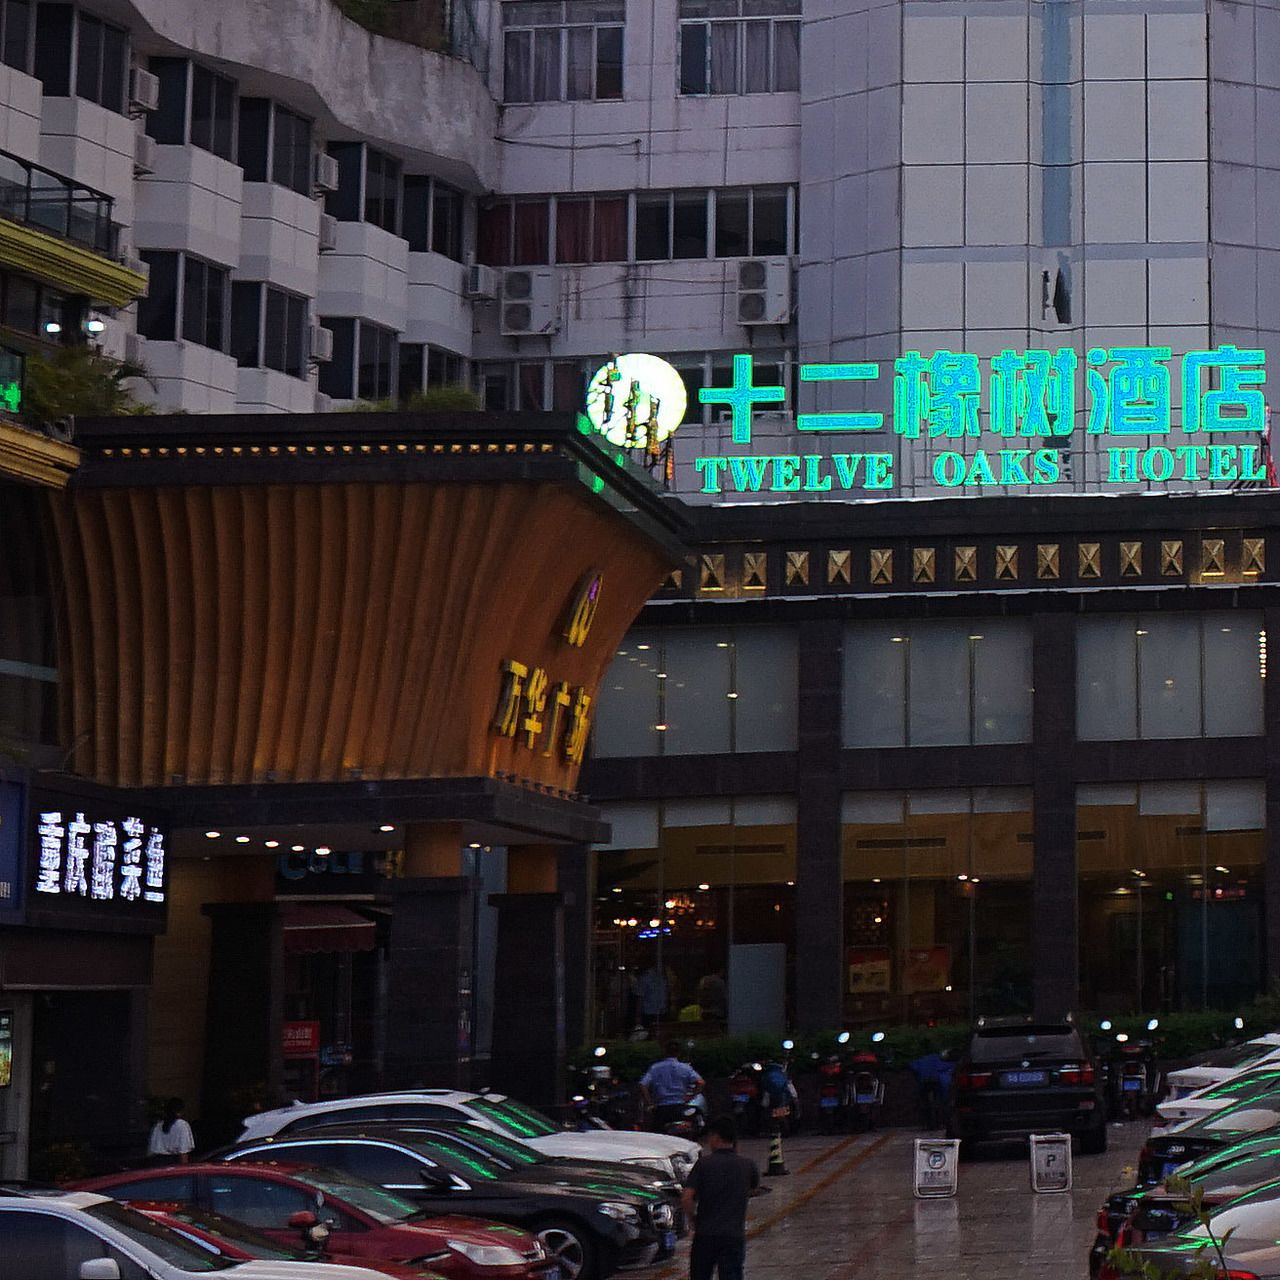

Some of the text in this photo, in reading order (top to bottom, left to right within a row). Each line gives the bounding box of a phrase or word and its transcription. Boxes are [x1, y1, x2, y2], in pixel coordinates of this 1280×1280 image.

[698, 345, 1268, 444] 十二橡树酒店
[695, 444, 1268, 494] TWELVE OAKS HOTEL
